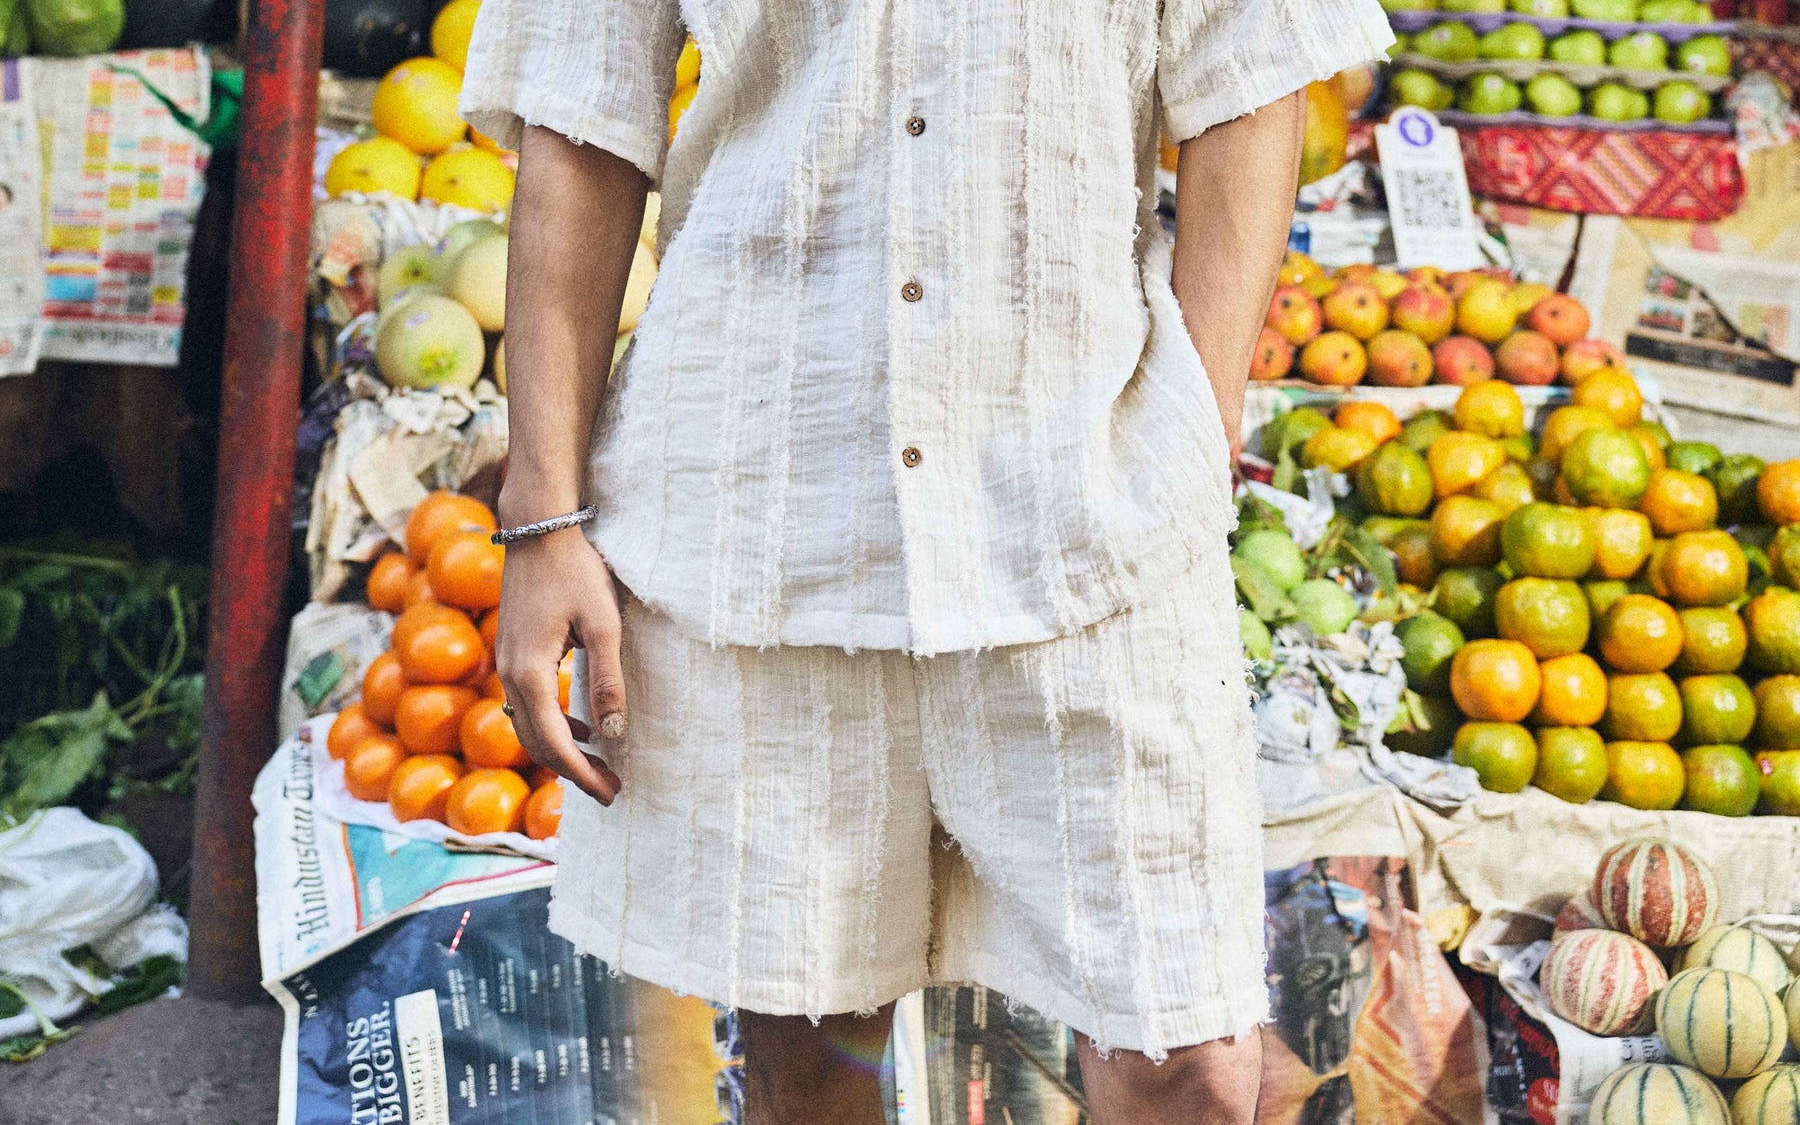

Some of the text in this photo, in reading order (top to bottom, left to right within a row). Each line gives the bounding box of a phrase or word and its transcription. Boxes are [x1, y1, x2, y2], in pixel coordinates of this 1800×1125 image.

[284, 743, 329, 941] Hindustan Times
[369, 1000, 403, 1125] BIGGER.
[406, 1036, 427, 1121] BENEFITS
